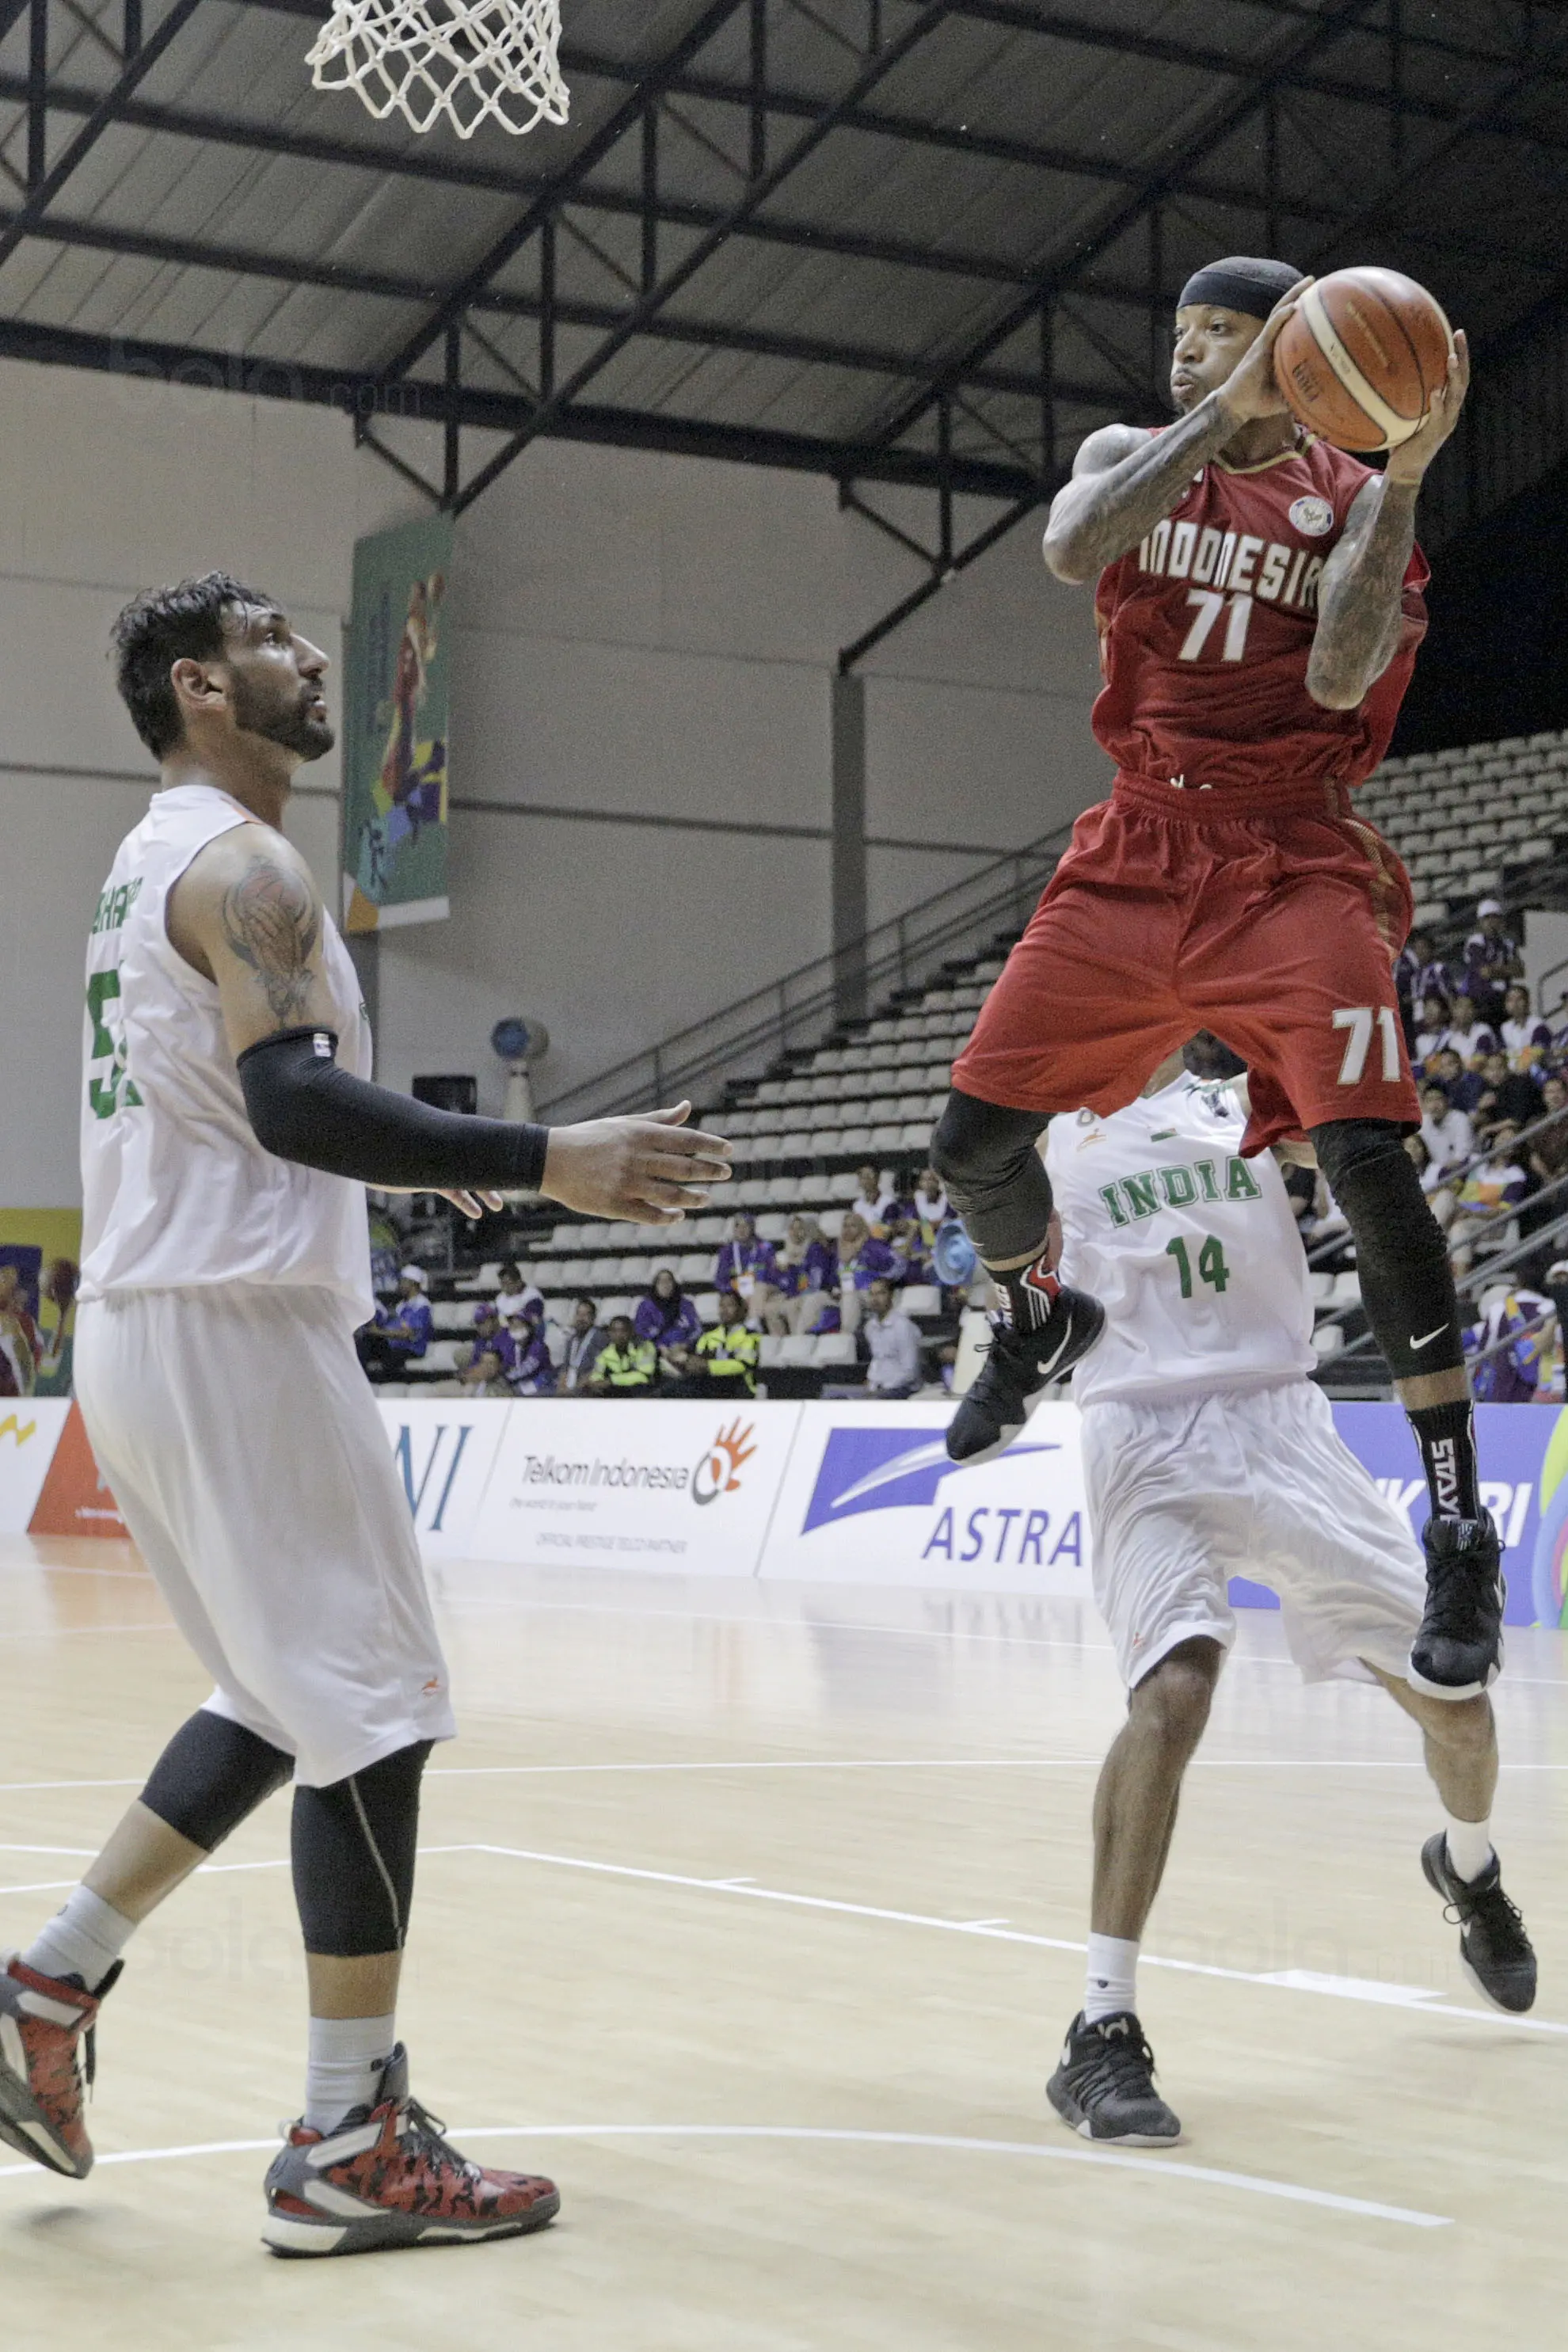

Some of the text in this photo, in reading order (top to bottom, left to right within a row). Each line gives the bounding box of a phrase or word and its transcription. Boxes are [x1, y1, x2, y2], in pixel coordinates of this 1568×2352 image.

[1139, 519, 1325, 609] INDONESIA
[1178, 588, 1253, 663] 71
[1332, 1007, 1402, 1086] 71
[1098, 1155, 1263, 1229] INDIA
[1166, 1234, 1231, 1300] 14
[521, 1454, 690, 1490] Telkom Indonesia
[920, 1505, 1084, 1567] ASTRA
